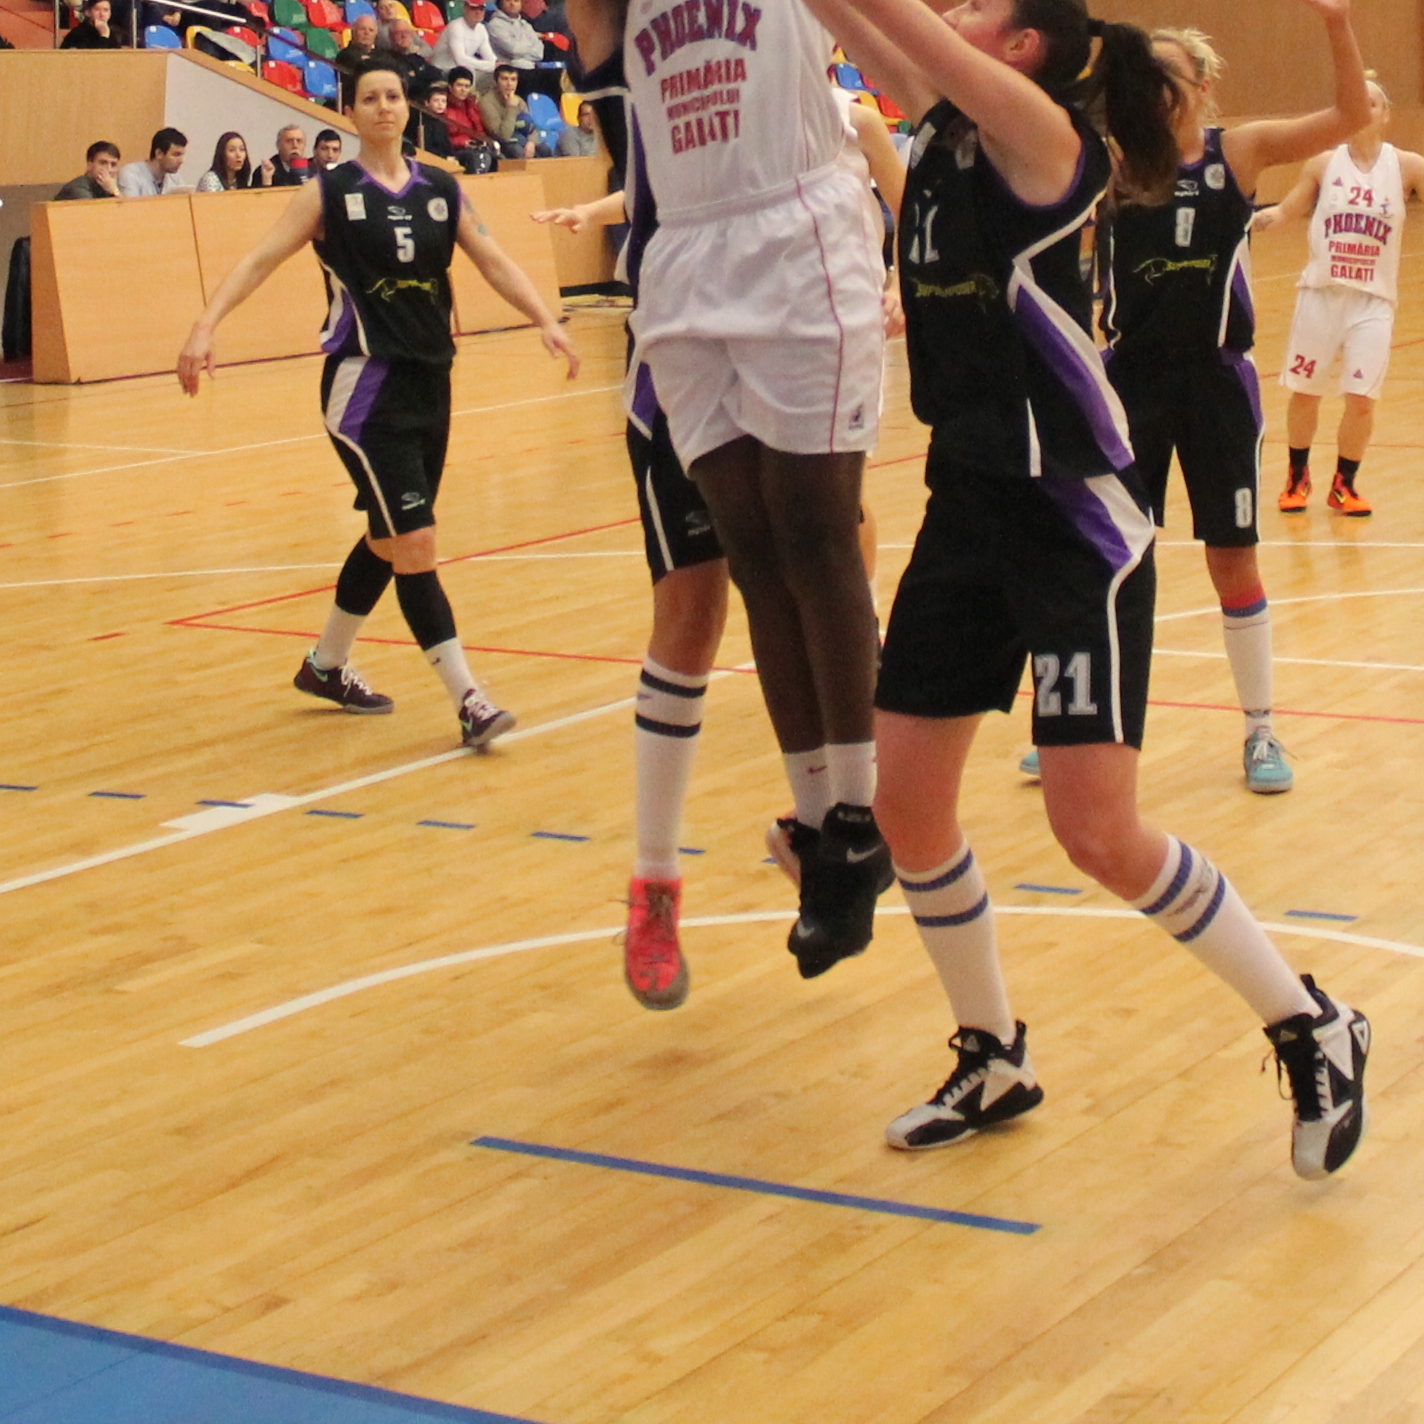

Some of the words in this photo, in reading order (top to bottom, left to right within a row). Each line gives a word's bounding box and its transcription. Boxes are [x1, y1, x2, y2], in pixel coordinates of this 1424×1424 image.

[1348, 186, 1374, 208] 24
[394, 226, 415, 263] 5
[1324, 213, 1392, 245] PHOENIX
[1290, 354, 1317, 379] 24
[1034, 651, 1098, 717] 21
